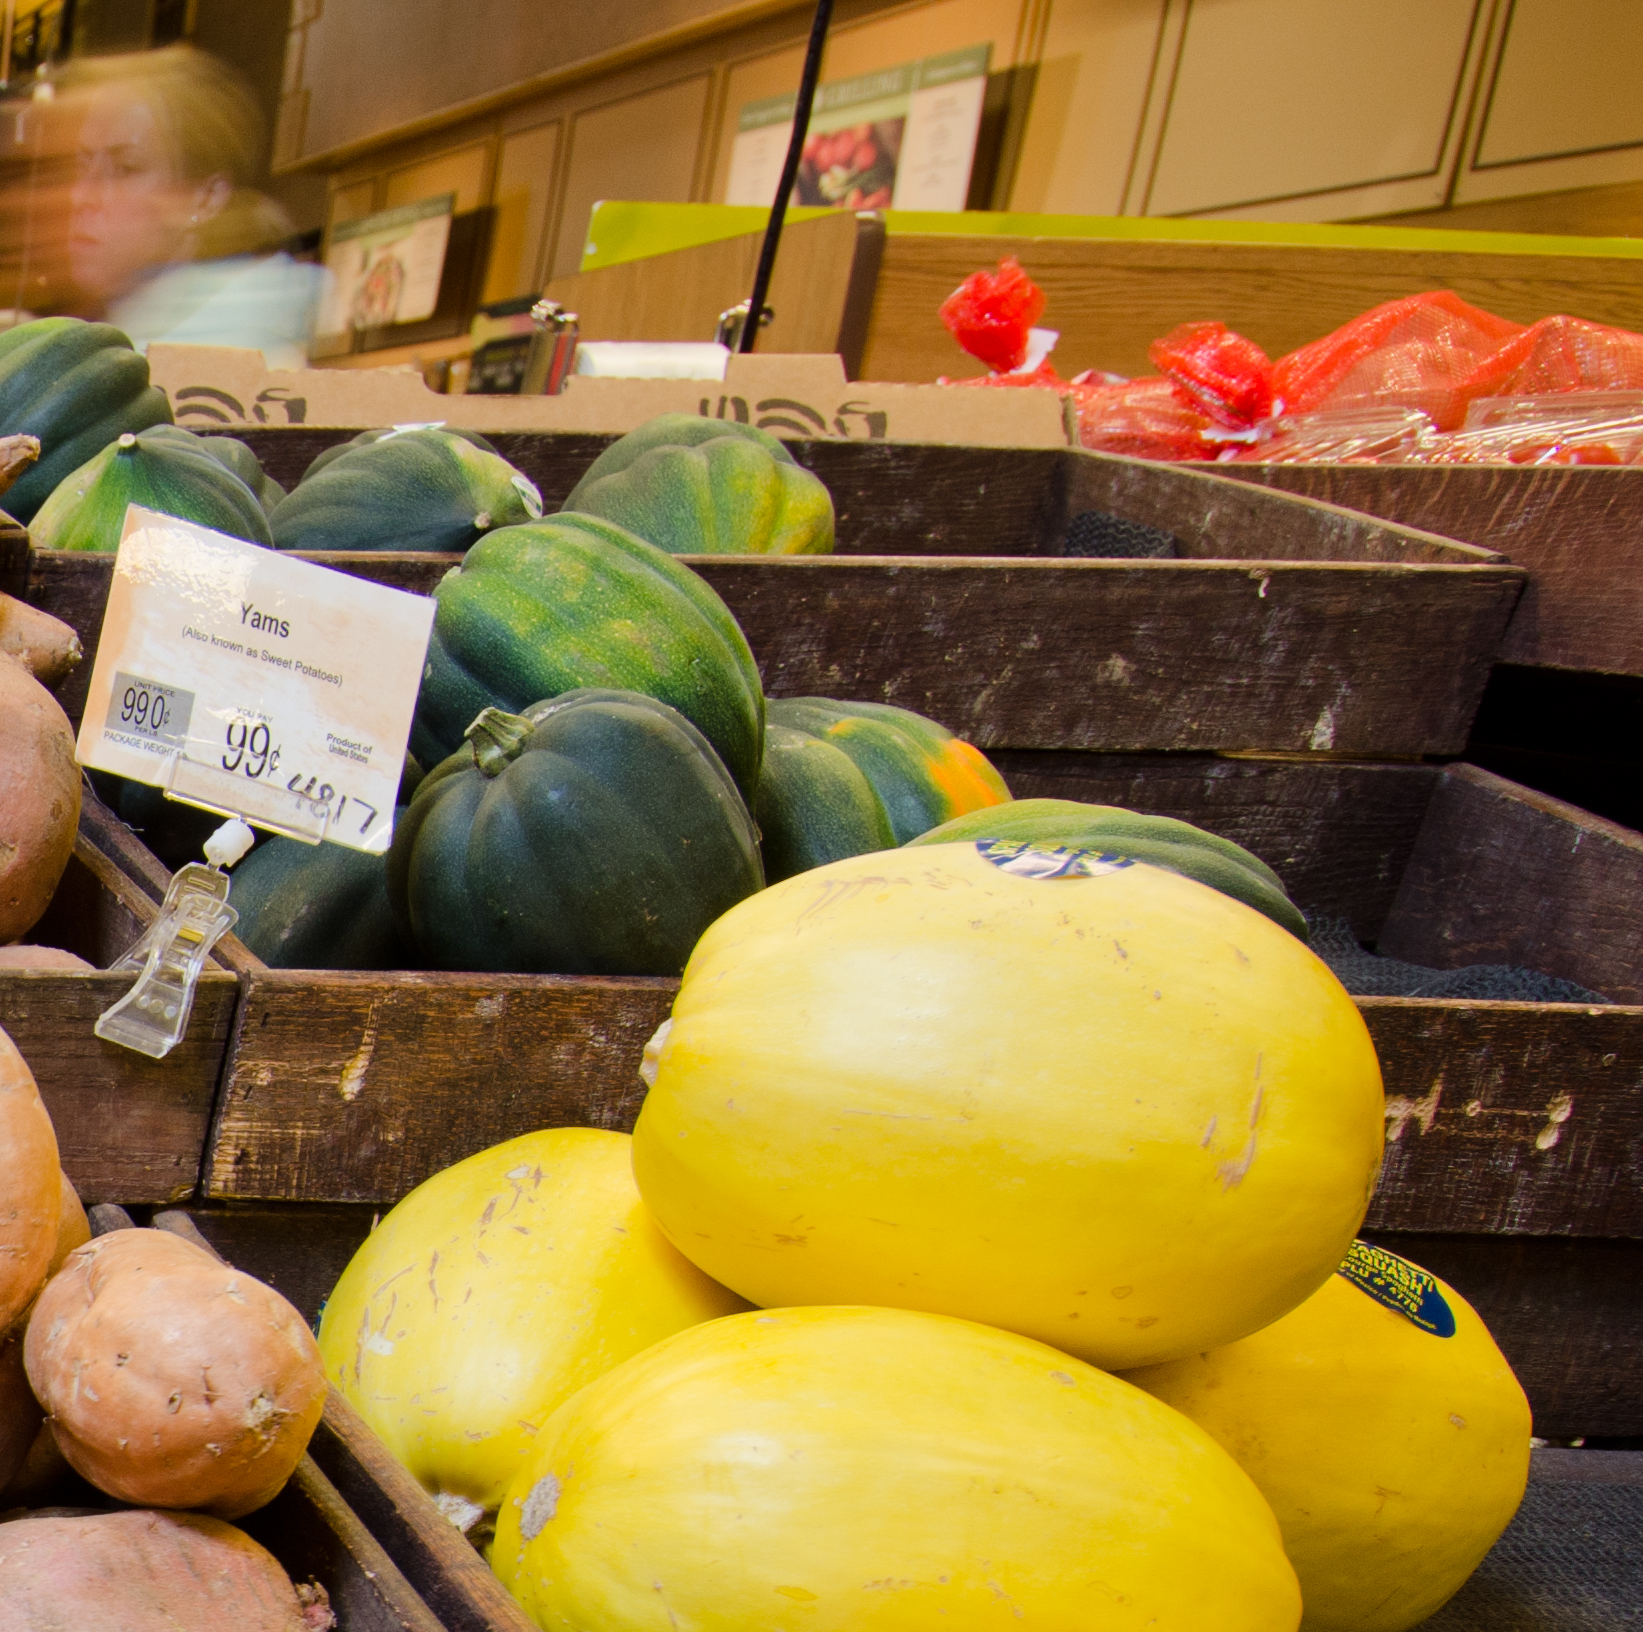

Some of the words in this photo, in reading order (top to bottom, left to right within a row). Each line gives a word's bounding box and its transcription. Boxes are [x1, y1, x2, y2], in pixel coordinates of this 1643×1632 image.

[241, 601, 290, 639] Yams
[182, 624, 208, 643] (Also
[210, 633, 244, 654] known
[246, 646, 258, 659] as
[260, 650, 293, 670] Sweet
[294, 660, 344, 688] Potatoes)
[134, 680, 152, 691] UNIT
[153, 685, 176, 698] PRICE
[237, 706, 254, 719] YOU
[256, 711, 274, 723] PAY
[134, 725, 148, 735] PER
[103, 730, 142, 749] PACKAGE
[143, 739, 175, 758] WEIGHT
[326, 733, 362, 751] Product
[363, 744, 373, 755] of
[328, 743, 349, 758] United
[349, 750, 369, 764] States
[287, 773, 378, 834] 4817
[1339, 1260, 1369, 1278] PLU
[1348, 1247, 1423, 1296] SQUASH
[1351, 1244, 1434, 1292] AGHETTI
